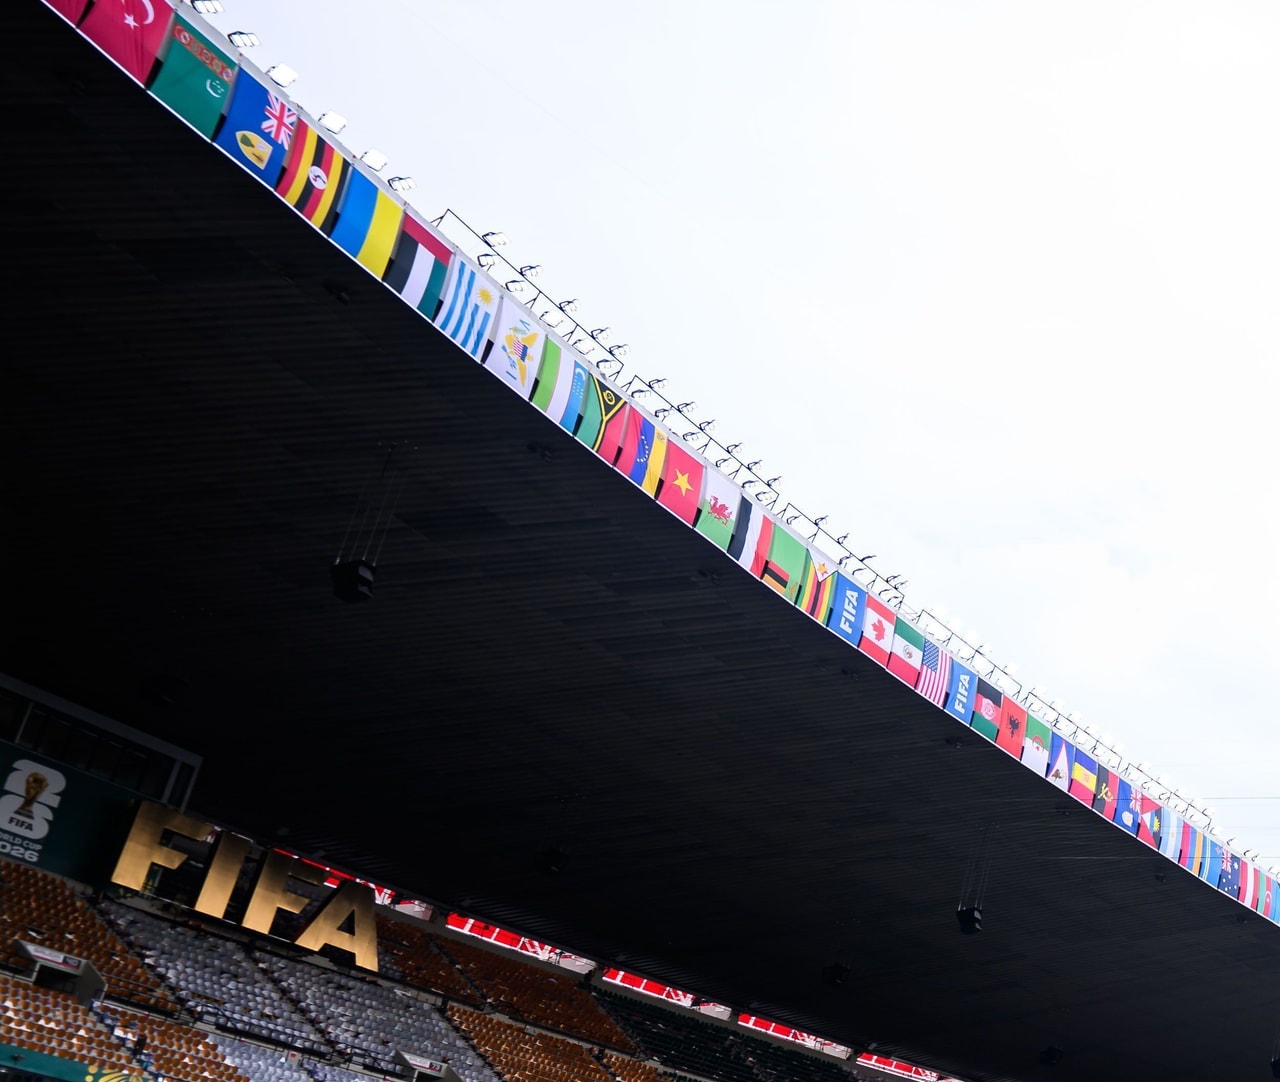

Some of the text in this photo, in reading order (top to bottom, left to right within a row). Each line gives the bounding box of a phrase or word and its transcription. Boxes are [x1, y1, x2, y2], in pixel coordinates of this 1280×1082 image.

[840, 590, 859, 634] FIFA
[954, 674, 970, 714] FIFA
[8, 816, 33, 832] FIFA
[110, 800, 380, 972] FIFA
